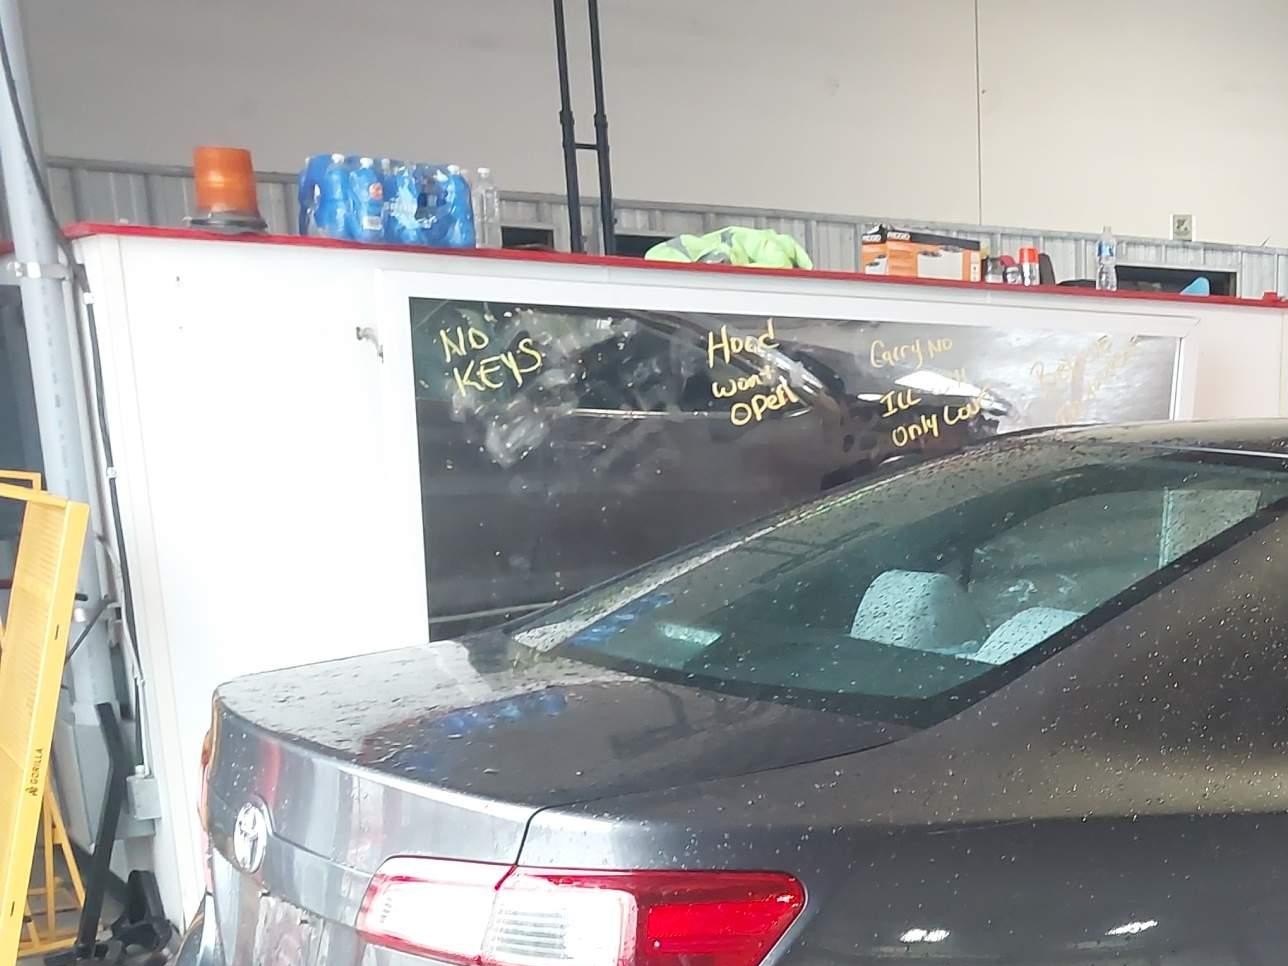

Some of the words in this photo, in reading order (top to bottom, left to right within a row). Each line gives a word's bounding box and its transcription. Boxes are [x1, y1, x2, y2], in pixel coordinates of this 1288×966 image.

[439, 326, 490, 363] NO
[707, 317, 780, 369] Hood
[453, 337, 543, 398] KEYS
[892, 413, 939, 447] Only
[29, 746, 44, 785] GORILLA
